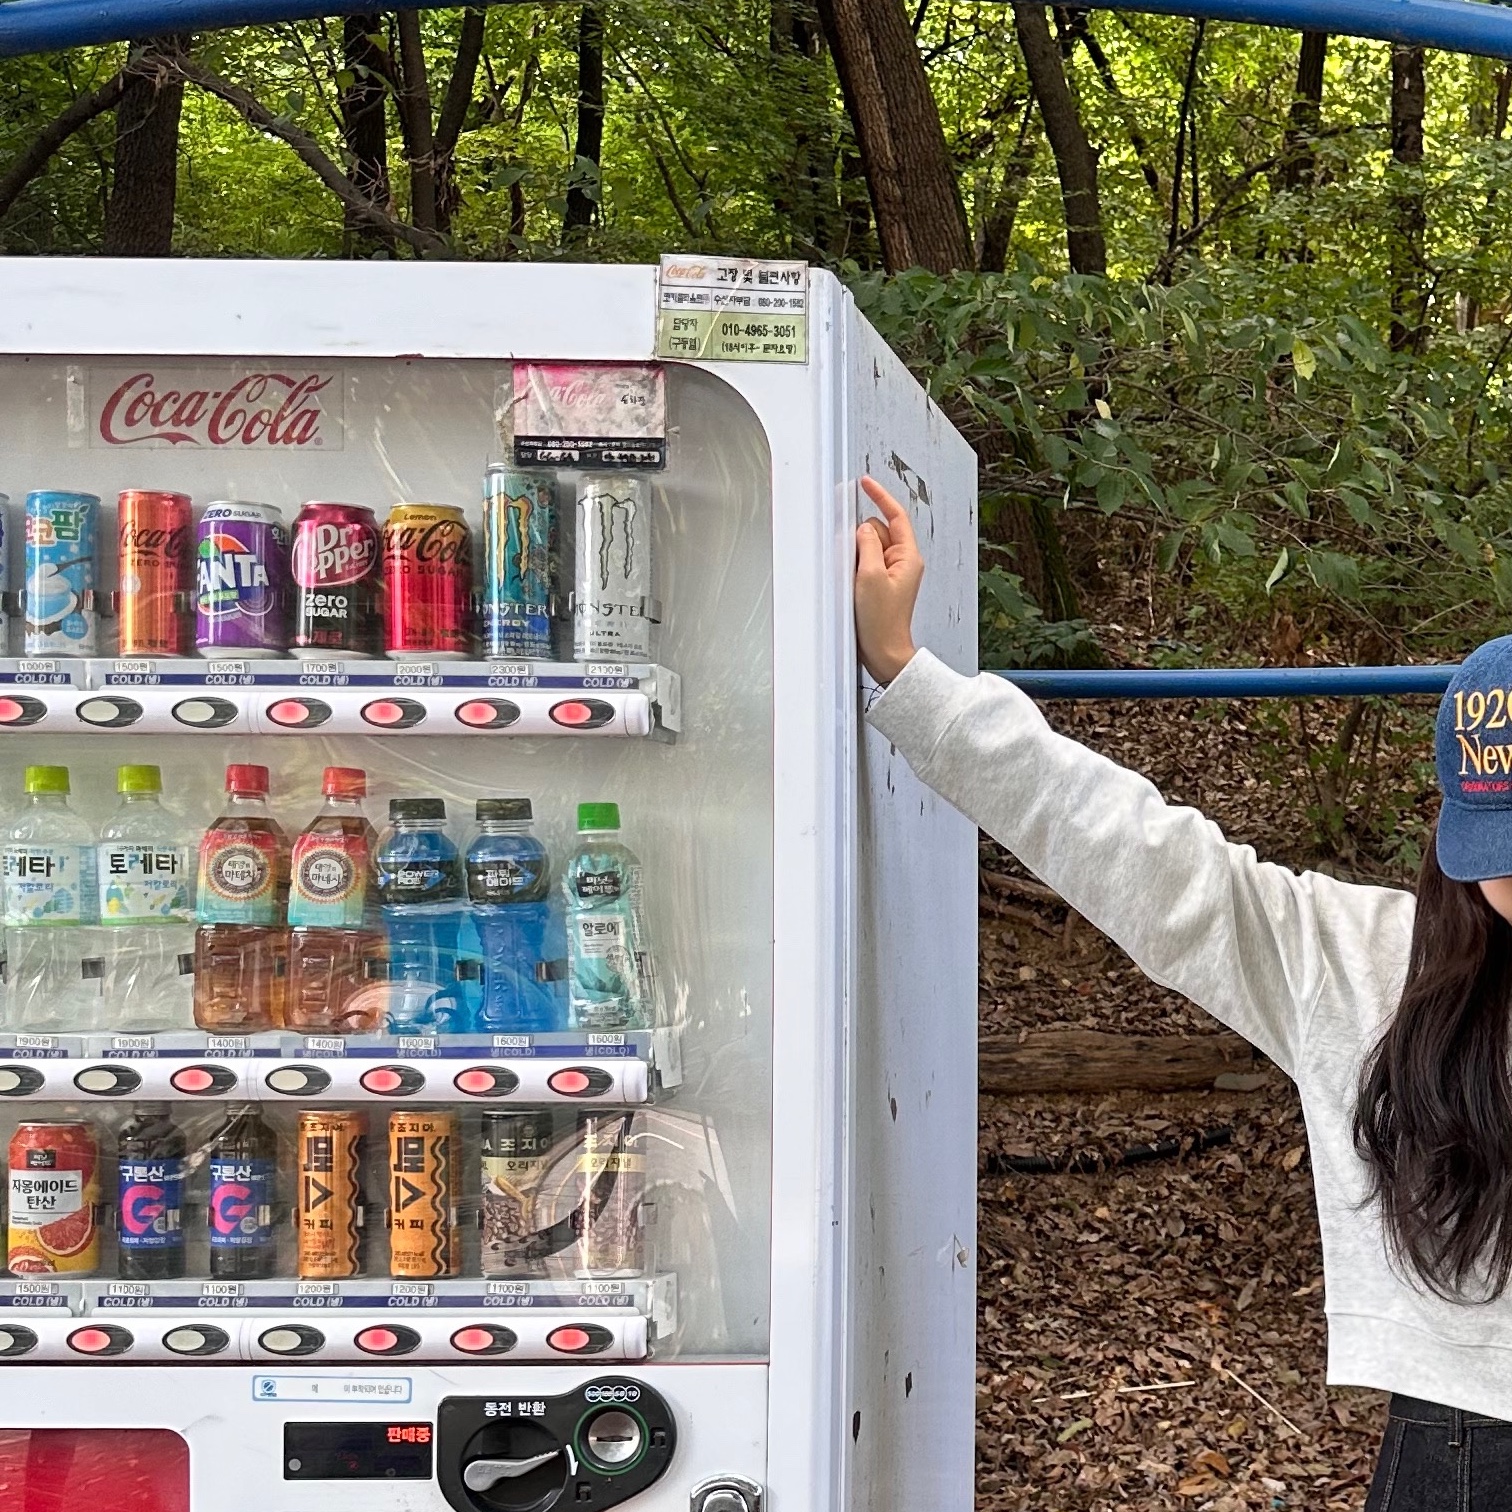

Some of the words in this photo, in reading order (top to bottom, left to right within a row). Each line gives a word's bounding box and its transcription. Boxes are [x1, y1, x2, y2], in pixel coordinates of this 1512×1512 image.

[721, 323, 797, 338] 010-4965-3051
[100, 373, 334, 445] Coca-Cola
[197, 553, 269, 594] ANTA
[305, 593, 348, 608] zero
[305, 608, 348, 618] SUGAR
[15, 674, 47, 684] COLD
[111, 674, 143, 684] COLD
[205, 675, 237, 685] COLD
[300, 675, 331, 685] COLD
[394, 676, 425, 686] COLD
[488, 677, 520, 686] COLD
[583, 677, 614, 688] COLD
[12, 1179, 78, 1194] 자몽에이드
[27, 1196, 56, 1210] 탄산
[13, 1297, 44, 1306] COLD
[104, 1298, 135, 1307] COLD
[198, 1298, 229, 1307] COLD
[293, 1297, 325, 1307] COLD
[388, 1297, 420, 1307] COLD
[483, 1297, 515, 1306] COLD
[578, 1297, 610, 1305] COLD
[484, 1401, 512, 1416] 동전
[518, 1401, 546, 1416] 반환
[388, 1427, 431, 1443] 판매중
